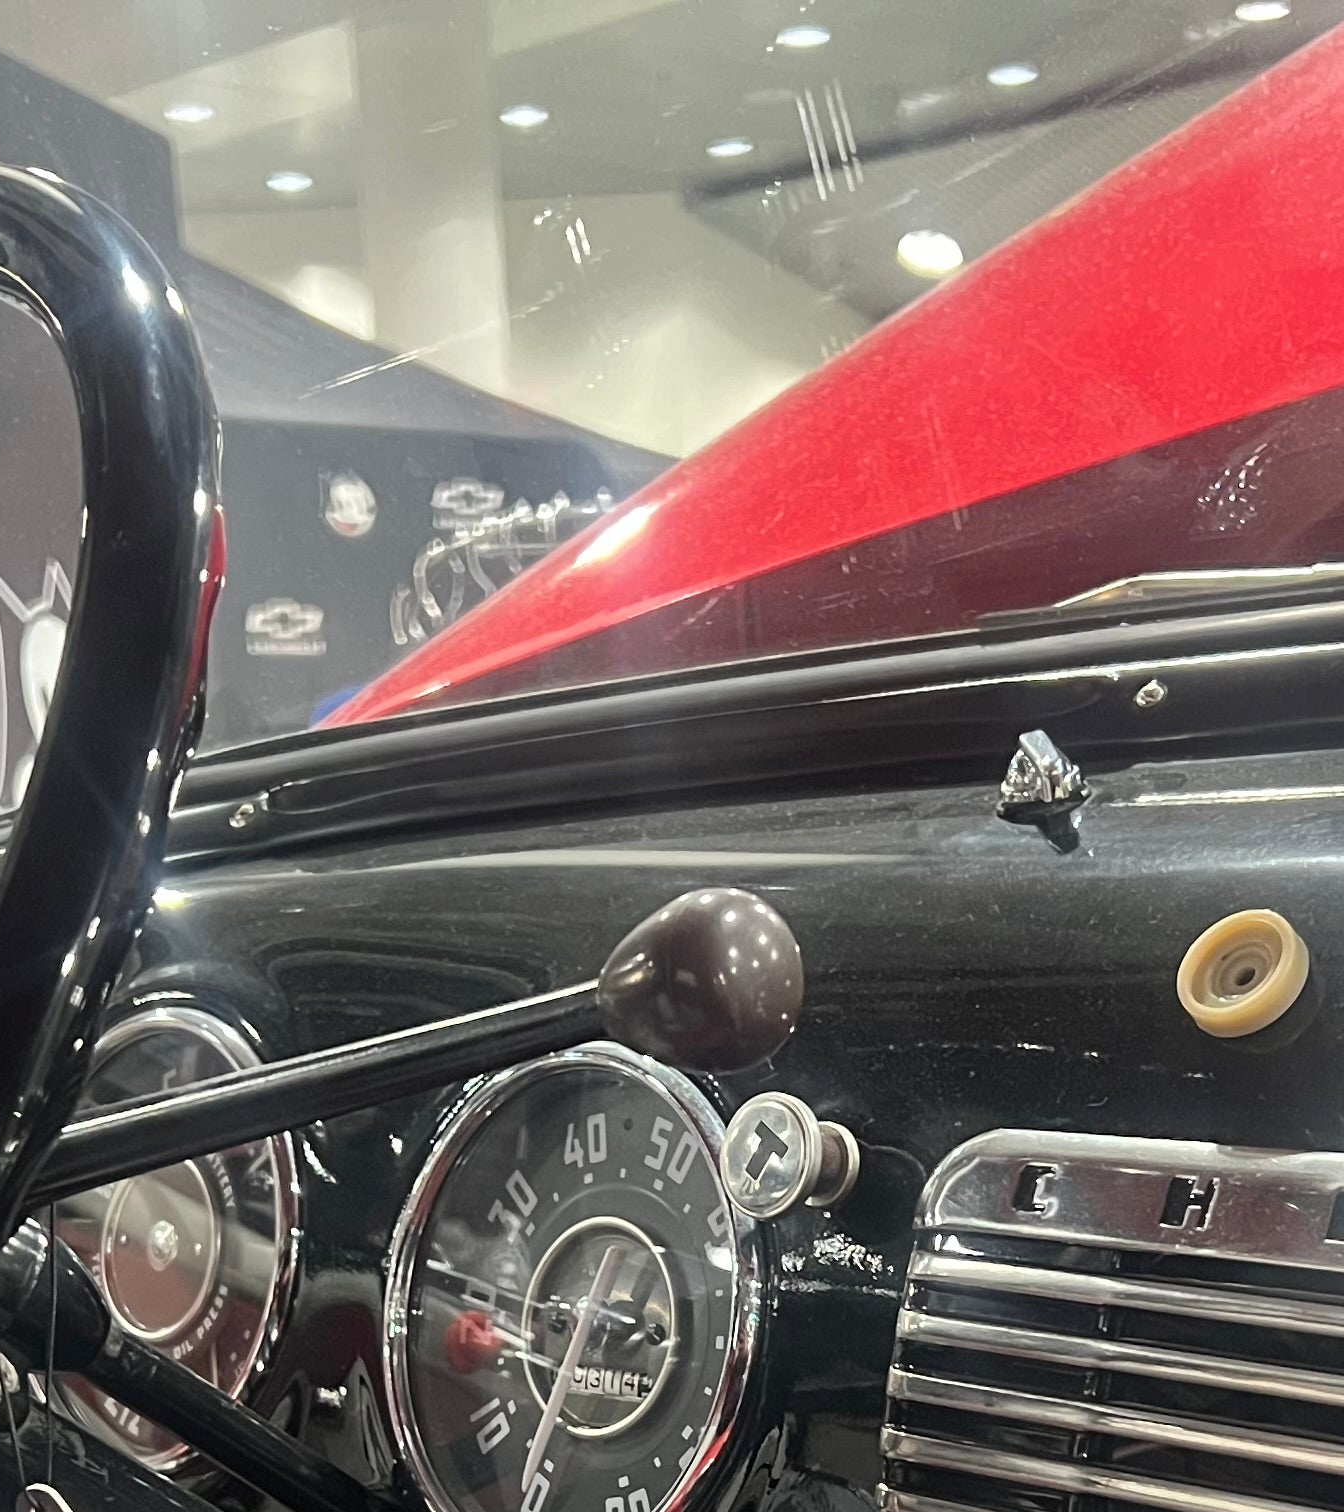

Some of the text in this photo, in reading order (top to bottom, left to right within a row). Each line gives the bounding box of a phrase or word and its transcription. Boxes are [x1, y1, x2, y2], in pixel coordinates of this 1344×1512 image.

[563, 1112, 607, 1168] 40
[643, 1115, 700, 1185] 50
[745, 1119, 789, 1181] T
[487, 1168, 538, 1243] 30
[172, 1339, 194, 1360] OIL
[470, 1397, 511, 1455] 10
